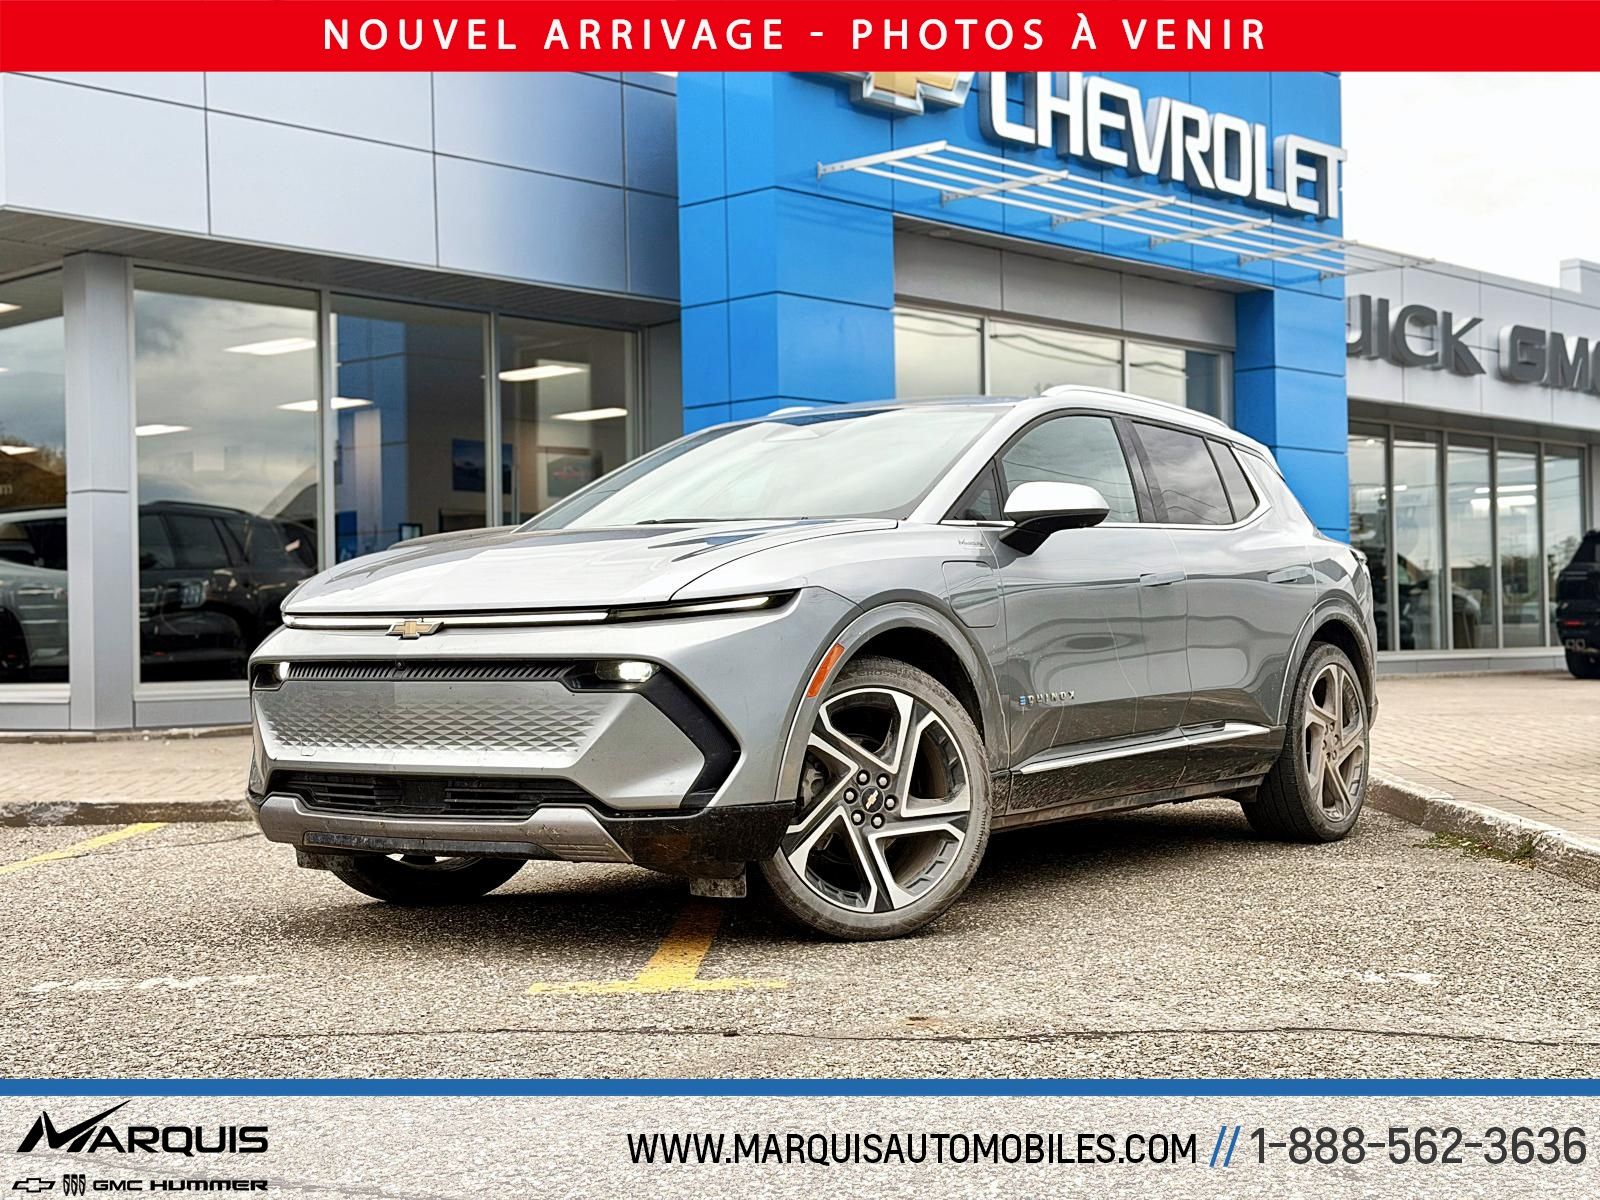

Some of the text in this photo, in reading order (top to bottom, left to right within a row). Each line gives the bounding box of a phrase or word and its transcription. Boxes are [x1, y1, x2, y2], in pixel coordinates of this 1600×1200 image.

[982, 72, 1346, 219] CHEVROLET
[1347, 295, 1600, 392] UICK GM
[1019, 690, 1074, 706] EQUINOX
